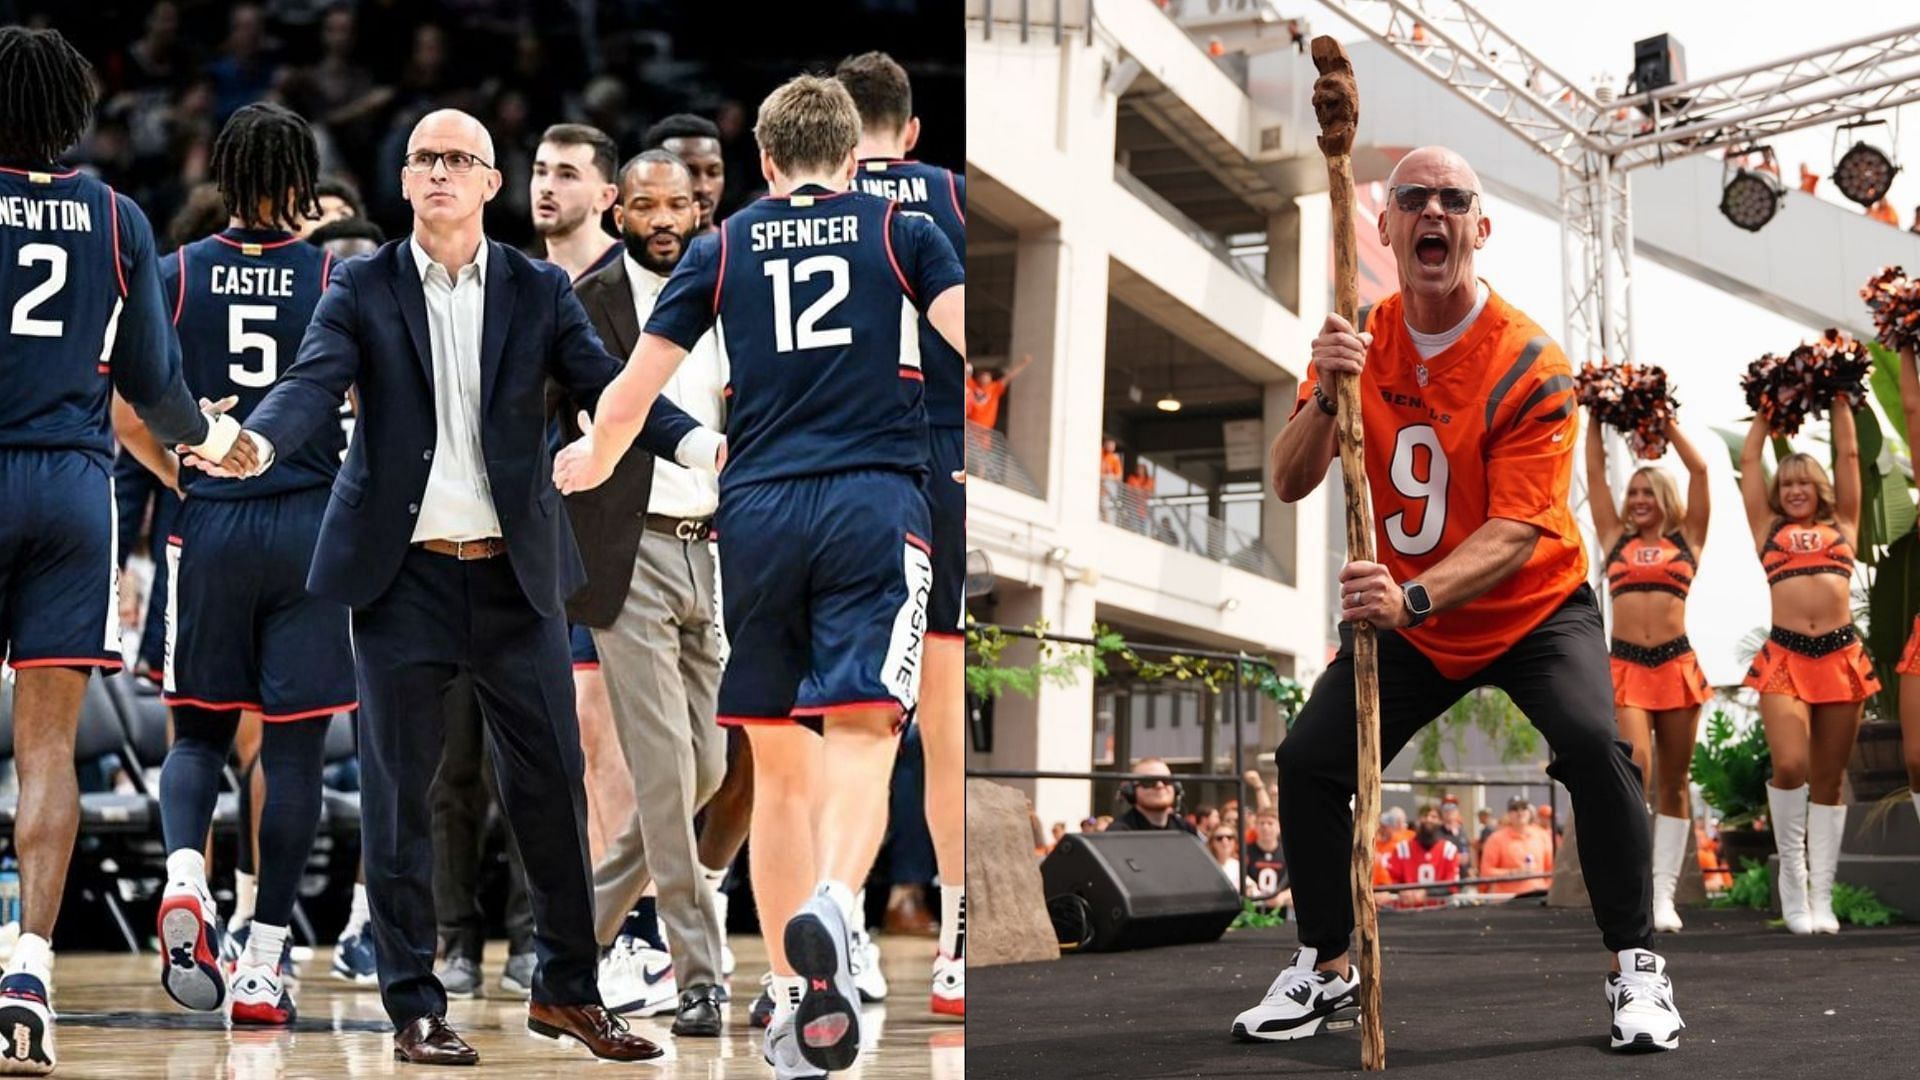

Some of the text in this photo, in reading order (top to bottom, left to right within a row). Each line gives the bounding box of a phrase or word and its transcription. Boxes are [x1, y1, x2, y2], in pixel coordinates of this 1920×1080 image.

[0, 195, 93, 232] NEWTON
[852, 178, 929, 203] INGAN
[751, 215, 858, 252] SPENCER
[10, 242, 68, 338] 2
[211, 265, 295, 297] CASTLE
[763, 254, 853, 353] 12
[228, 304, 278, 388] 5
[1384, 422, 1450, 557] 9
